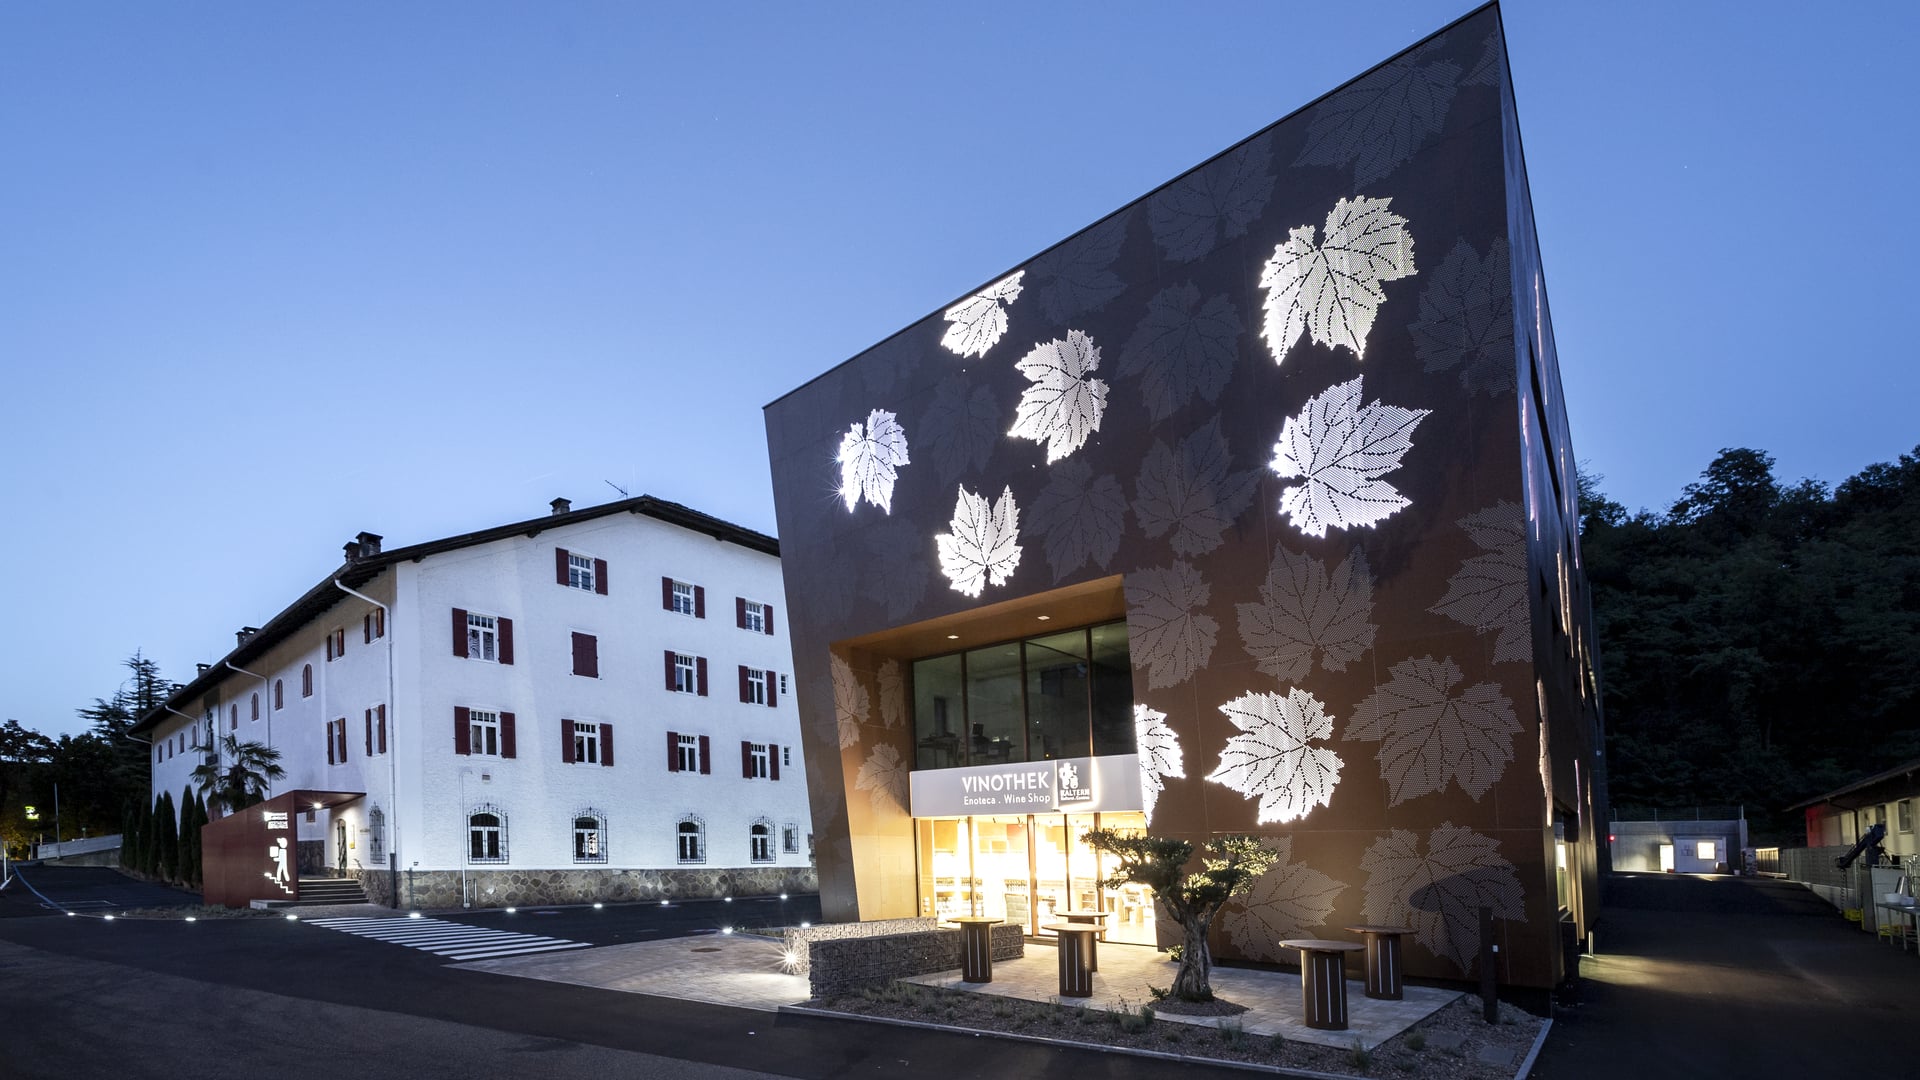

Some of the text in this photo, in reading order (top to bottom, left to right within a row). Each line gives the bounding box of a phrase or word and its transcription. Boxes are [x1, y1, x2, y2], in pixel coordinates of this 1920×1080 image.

[962, 771, 1049, 793] VINOTHEK
[963, 795, 996, 806] Enoteca
[1003, 794, 1026, 804] Wine
[1027, 793, 1051, 804] Shop
[1060, 789, 1090, 797] KALTERN
